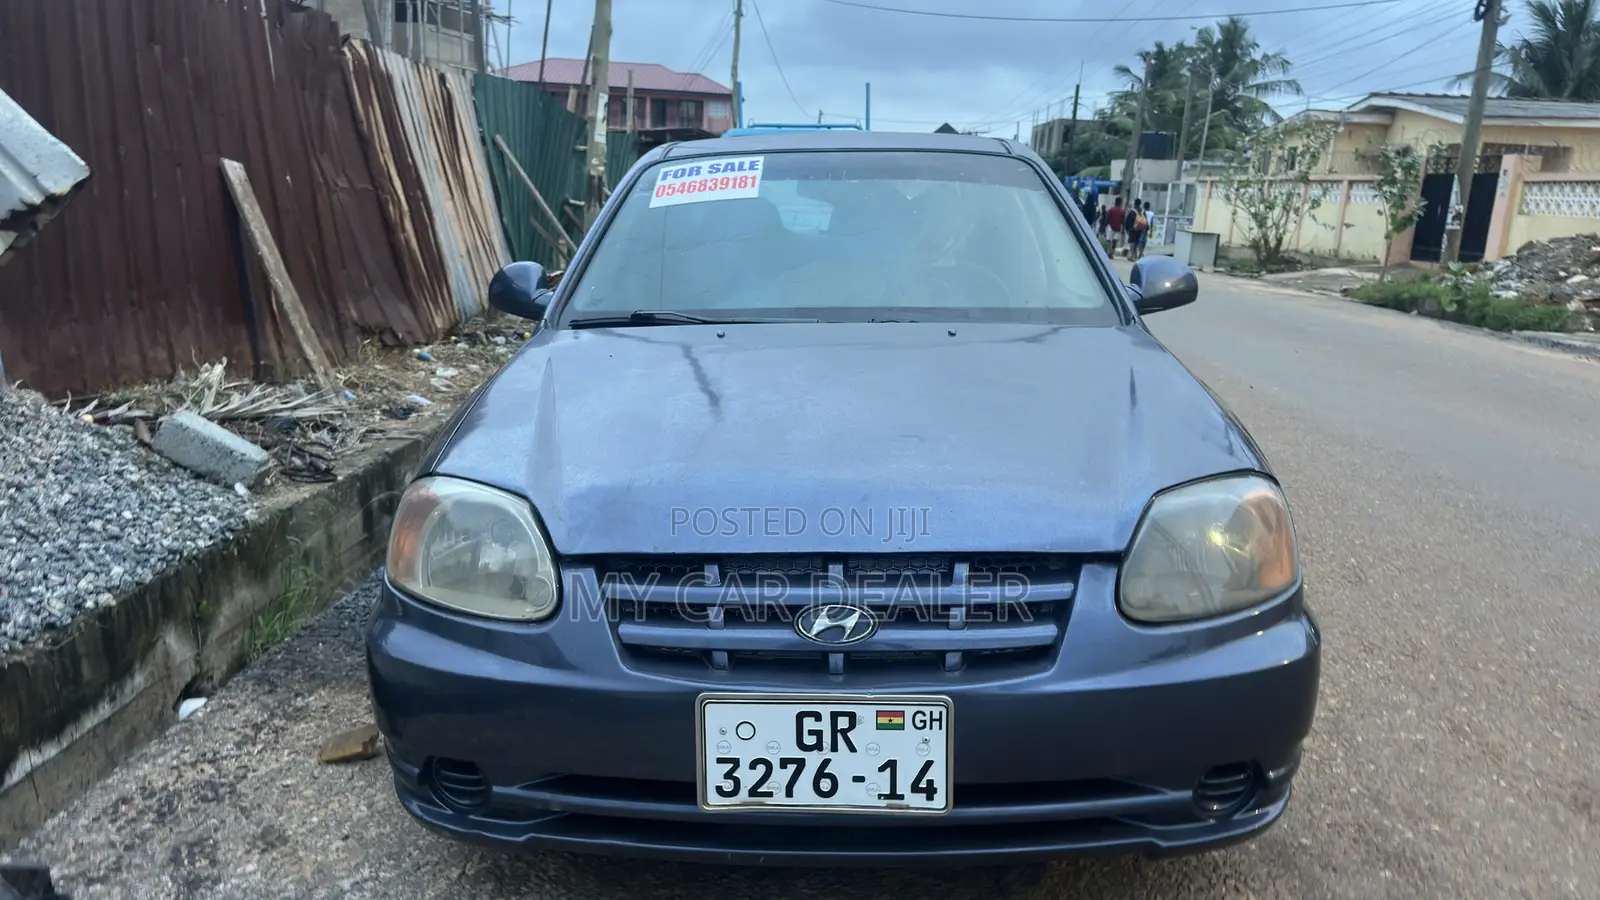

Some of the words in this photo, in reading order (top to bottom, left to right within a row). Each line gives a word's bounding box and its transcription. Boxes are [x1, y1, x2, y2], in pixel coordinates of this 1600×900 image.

[661, 166, 702, 181] FOR
[708, 160, 760, 174] SALE
[655, 175, 757, 198] 0546839181
[796, 710, 857, 753] GR
[912, 711, 942, 730] GH
